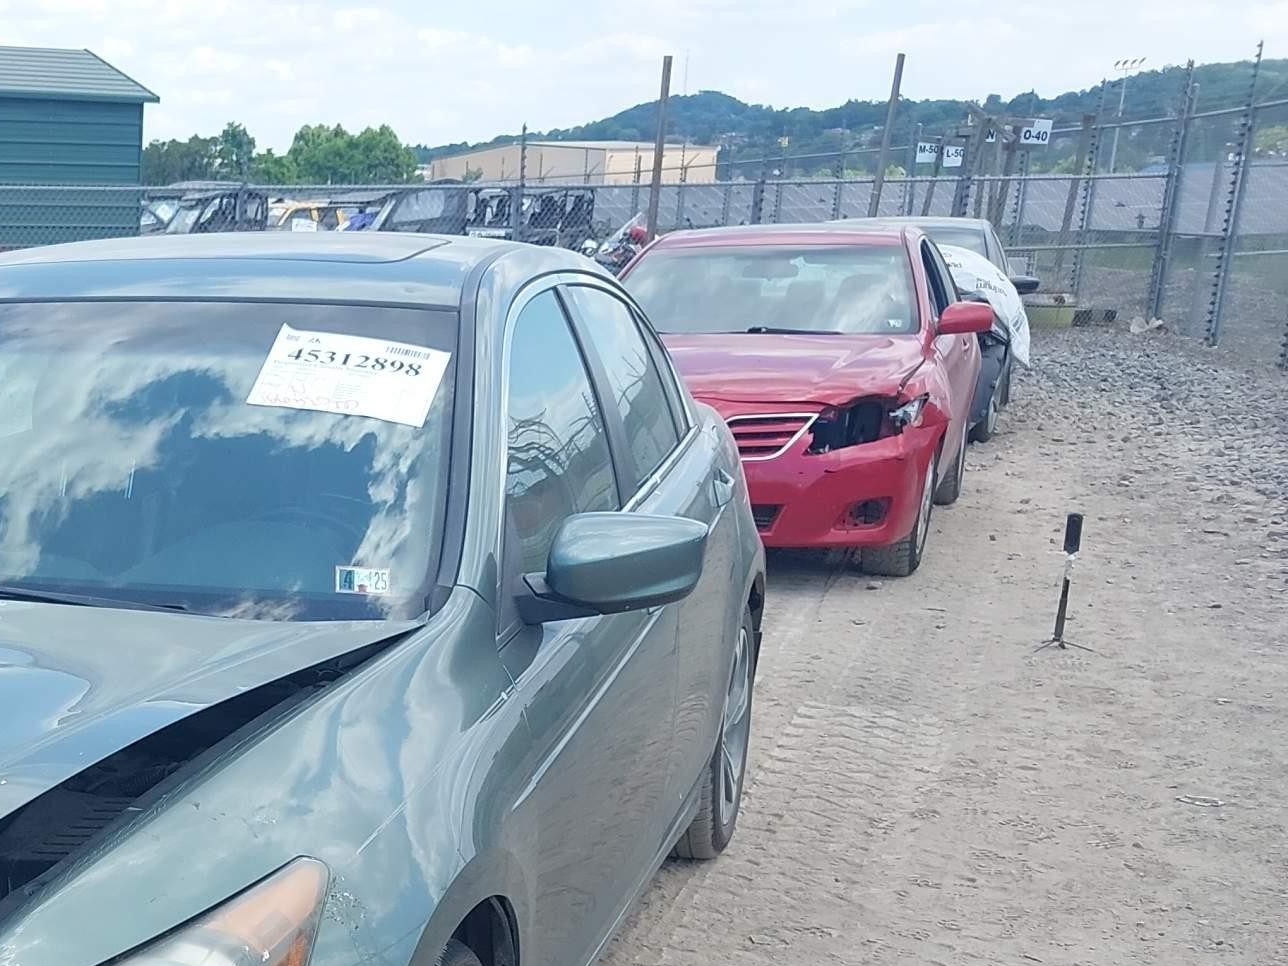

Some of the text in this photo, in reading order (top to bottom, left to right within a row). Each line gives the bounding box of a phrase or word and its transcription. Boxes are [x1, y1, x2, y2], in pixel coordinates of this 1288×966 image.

[1023, 130, 1048, 141] O-40
[918, 145, 939, 155] M-50
[946, 147, 964, 158] L-50
[287, 347, 423, 377] 45312898
